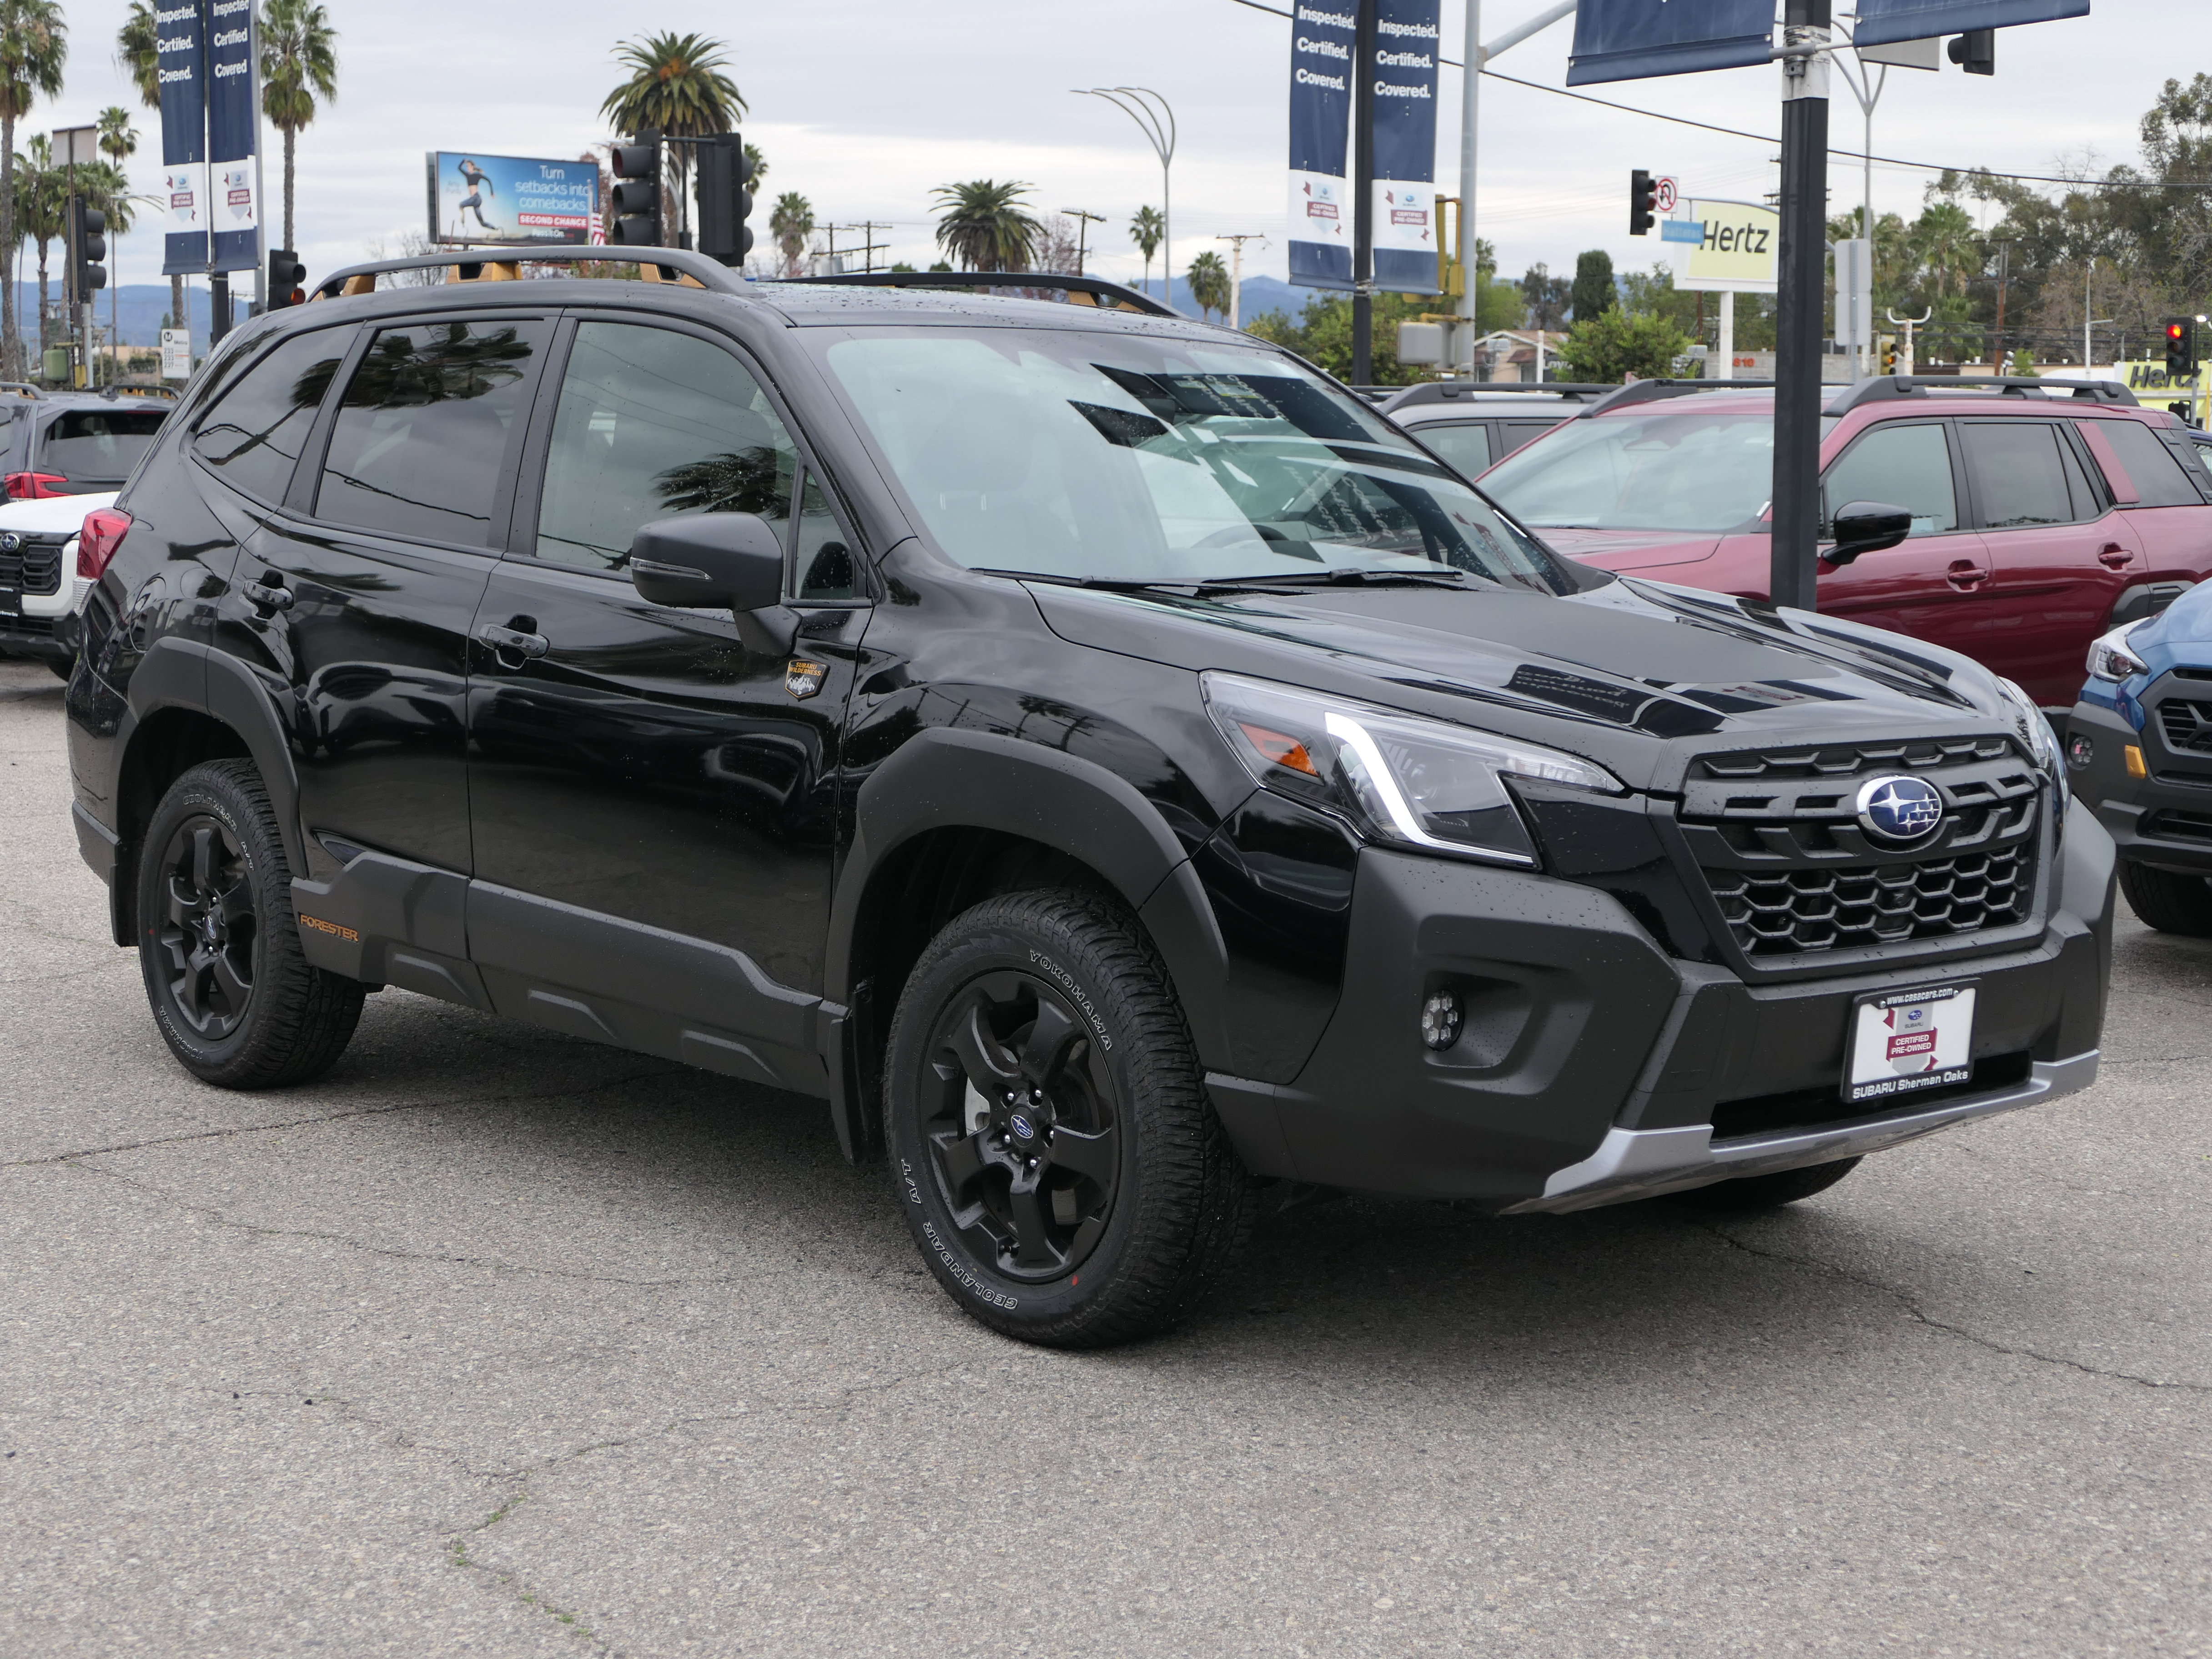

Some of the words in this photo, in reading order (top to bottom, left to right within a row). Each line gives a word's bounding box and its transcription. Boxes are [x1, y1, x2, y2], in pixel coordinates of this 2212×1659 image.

[156, 4, 197, 25] Inspected.
[1298, 5, 1357, 30] Inspected.
[1377, 19, 1439, 38] Inspected.
[1297, 36, 1349, 60] Certified.
[1376, 50, 1433, 68] Certified.
[1296, 68, 1345, 90] Covered.
[1374, 80, 1431, 98] Covered.
[539, 165, 564, 179] Turn
[515, 180, 568, 196] setbacks
[569, 182, 589, 196] into
[519, 215, 553, 225] SECOND
[554, 217, 587, 227] CHANCE
[1699, 220, 1770, 253] Hertz
[789, 667, 821, 676] WILDERNESS
[300, 914, 359, 942] FORESTER
[1030, 949, 1112, 1051] YOKOHAMA
[1887, 988, 1953, 1005] www.casacars.com
[158, 1006, 203, 1059] YOKOHAMA
[1896, 1034, 1930, 1046] CERTIFIED
[1891, 1042, 1931, 1055] PRE-OWNED
[1853, 1081, 1896, 1099] SUBARU
[1898, 1074, 1941, 1091] Sherman
[1943, 1070, 1968, 1082] Oaks
[901, 1159, 921, 1204] A/T
[923, 1222, 1018, 1310] GEOLANDAR
